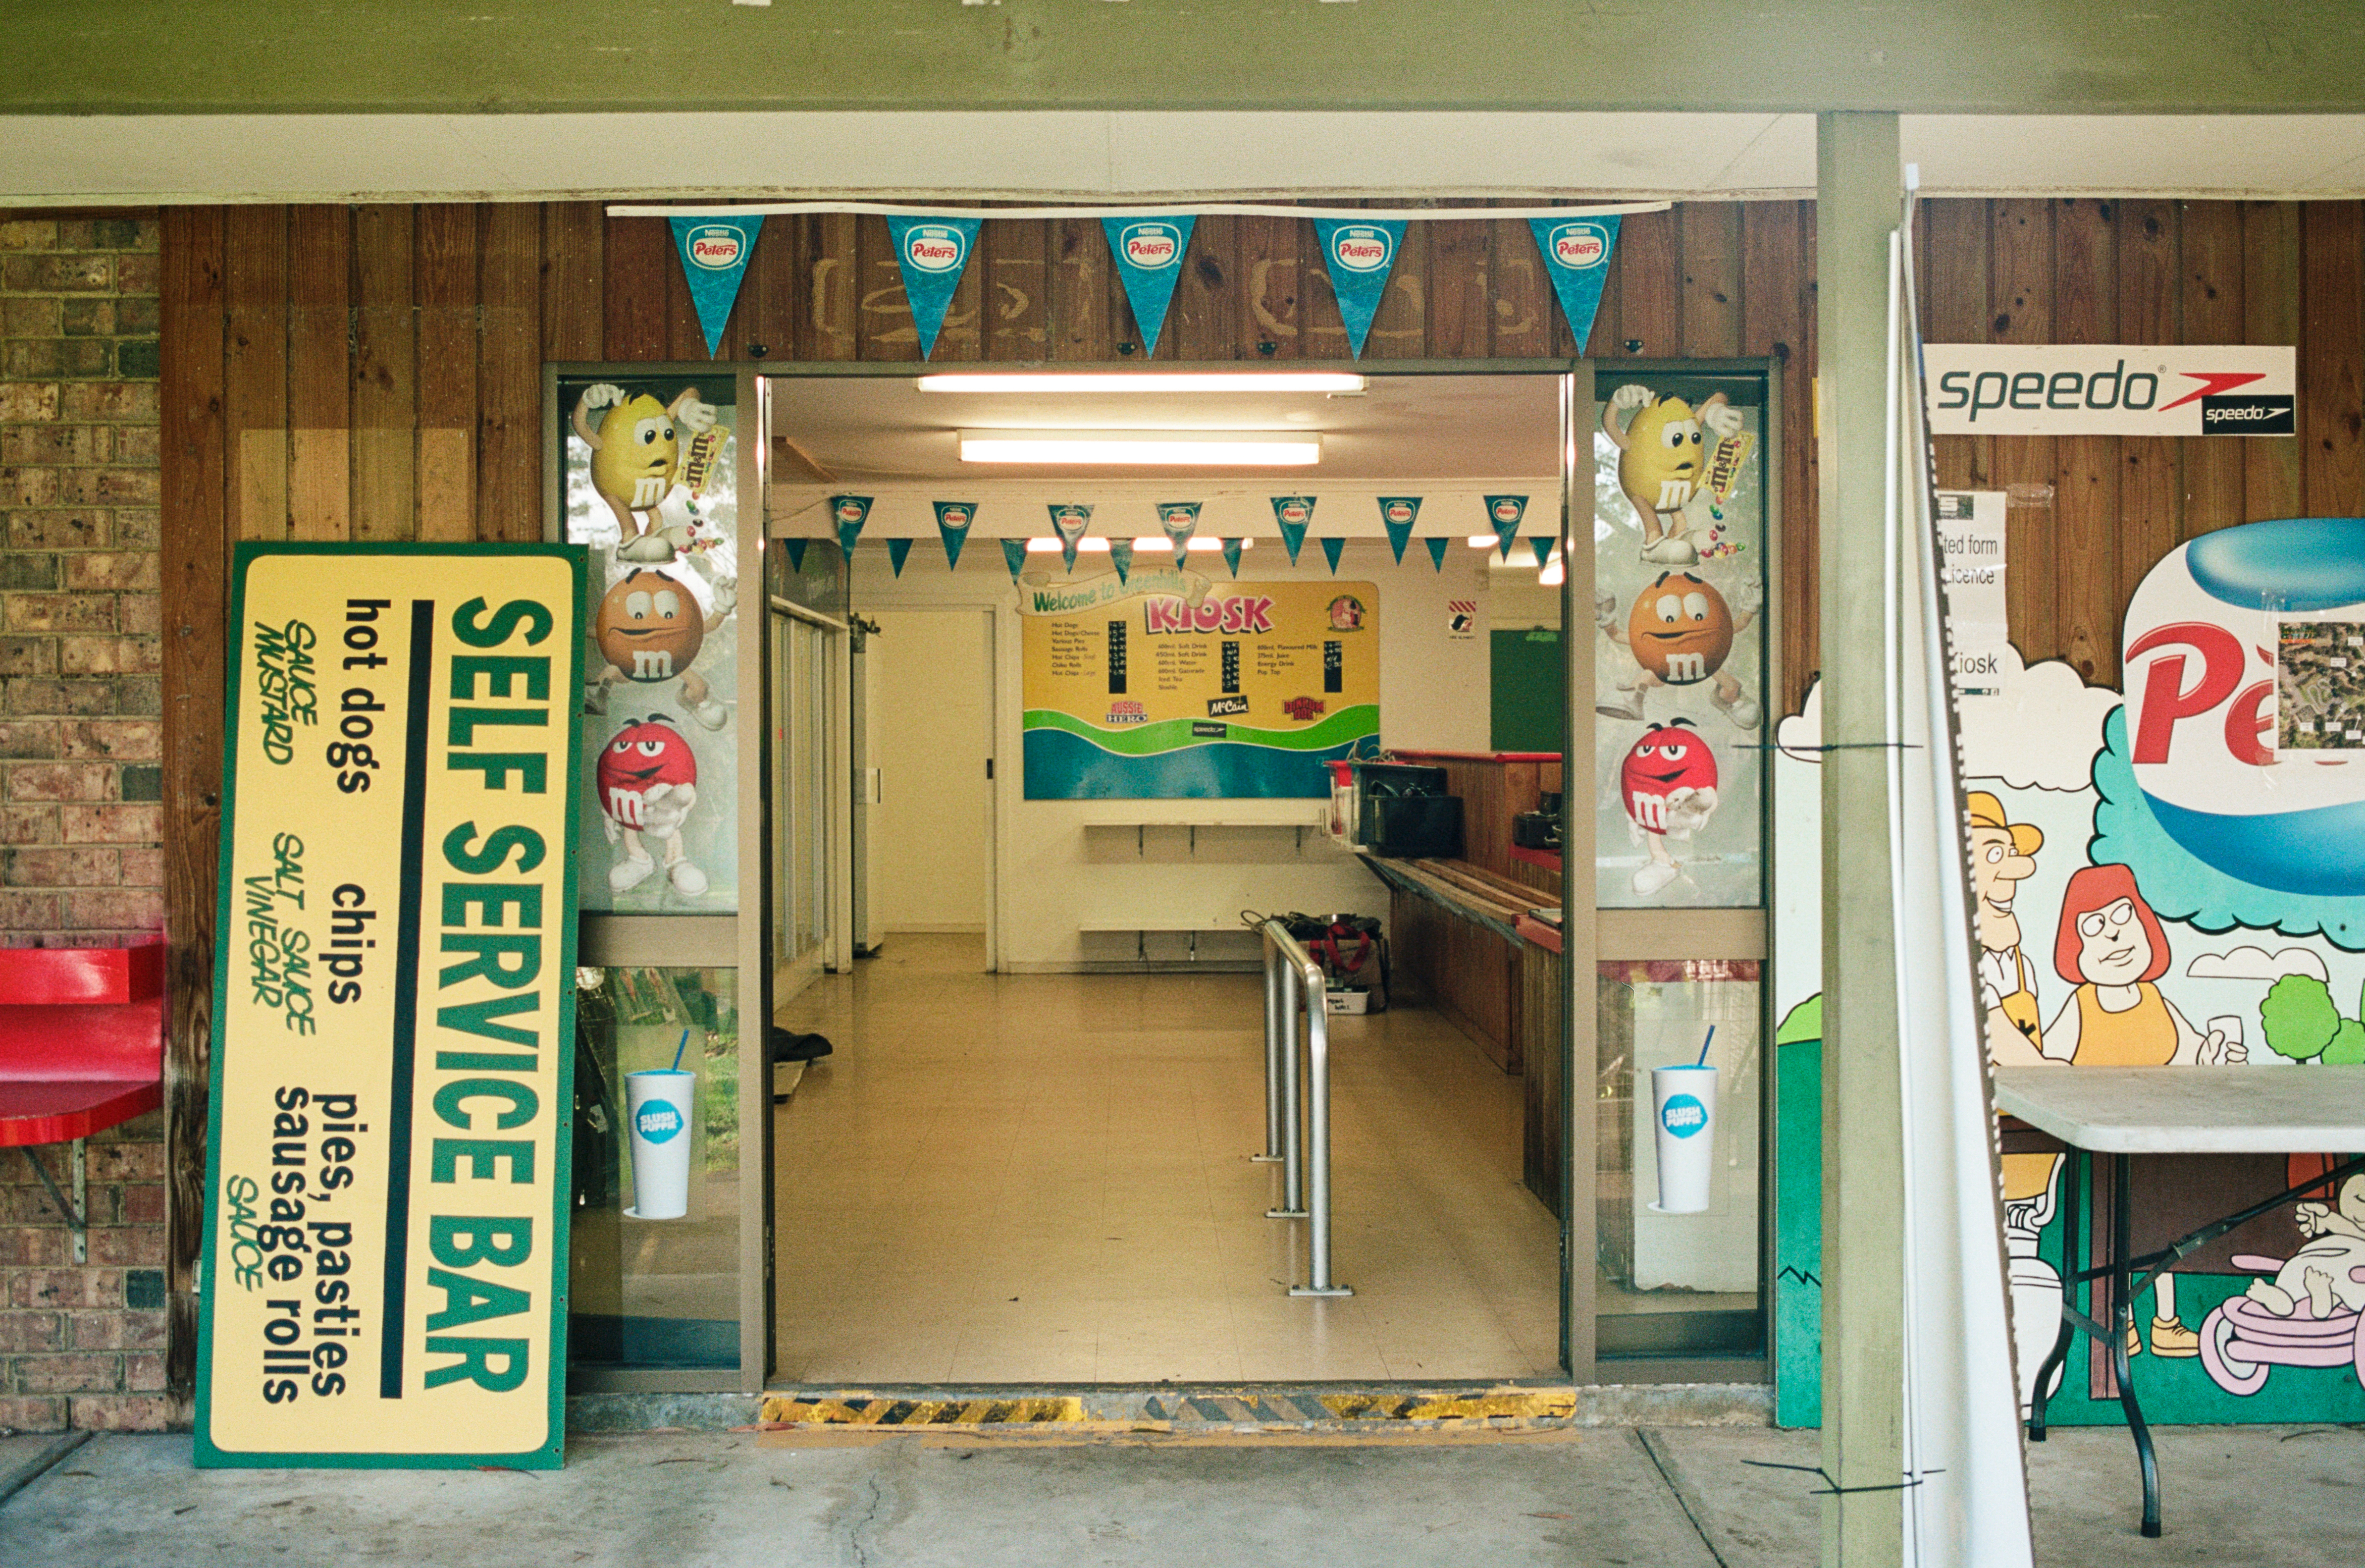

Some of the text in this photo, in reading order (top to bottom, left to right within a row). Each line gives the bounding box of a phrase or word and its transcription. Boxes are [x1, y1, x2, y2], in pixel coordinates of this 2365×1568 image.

[695, 242, 737, 255] Peters
[913, 243, 956, 258] Peters
[1129, 241, 1172, 254] Peters
[1340, 243, 1382, 257] Peters
[1558, 242, 1600, 255] Peters
[1943, 534, 1998, 554] ted form
[1033, 588, 1096, 612] Welcome
[1101, 581, 1115, 601] to
[1145, 594, 1275, 634] KIOSK
[284, 619, 318, 726] SAUCE
[254, 620, 294, 766] MUSTARD
[326, 599, 391, 794] hot dogs
[1111, 700, 1143, 714] AUSSIE
[1211, 700, 1248, 715] McCain
[244, 876, 283, 1008] VINEGAR
[273, 832, 317, 1036] SALT SAUCE
[319, 883, 376, 1004] chips
[424, 596, 554, 1393] SELF SERVICE BAR
[640, 1111, 676, 1124] SLUSH
[1666, 1106, 1701, 1118] SLUSH
[227, 1175, 263, 1292] SAUCE
[257, 1086, 311, 1404] sausage rolls
[307, 1093, 367, 1397] pies, pasties
